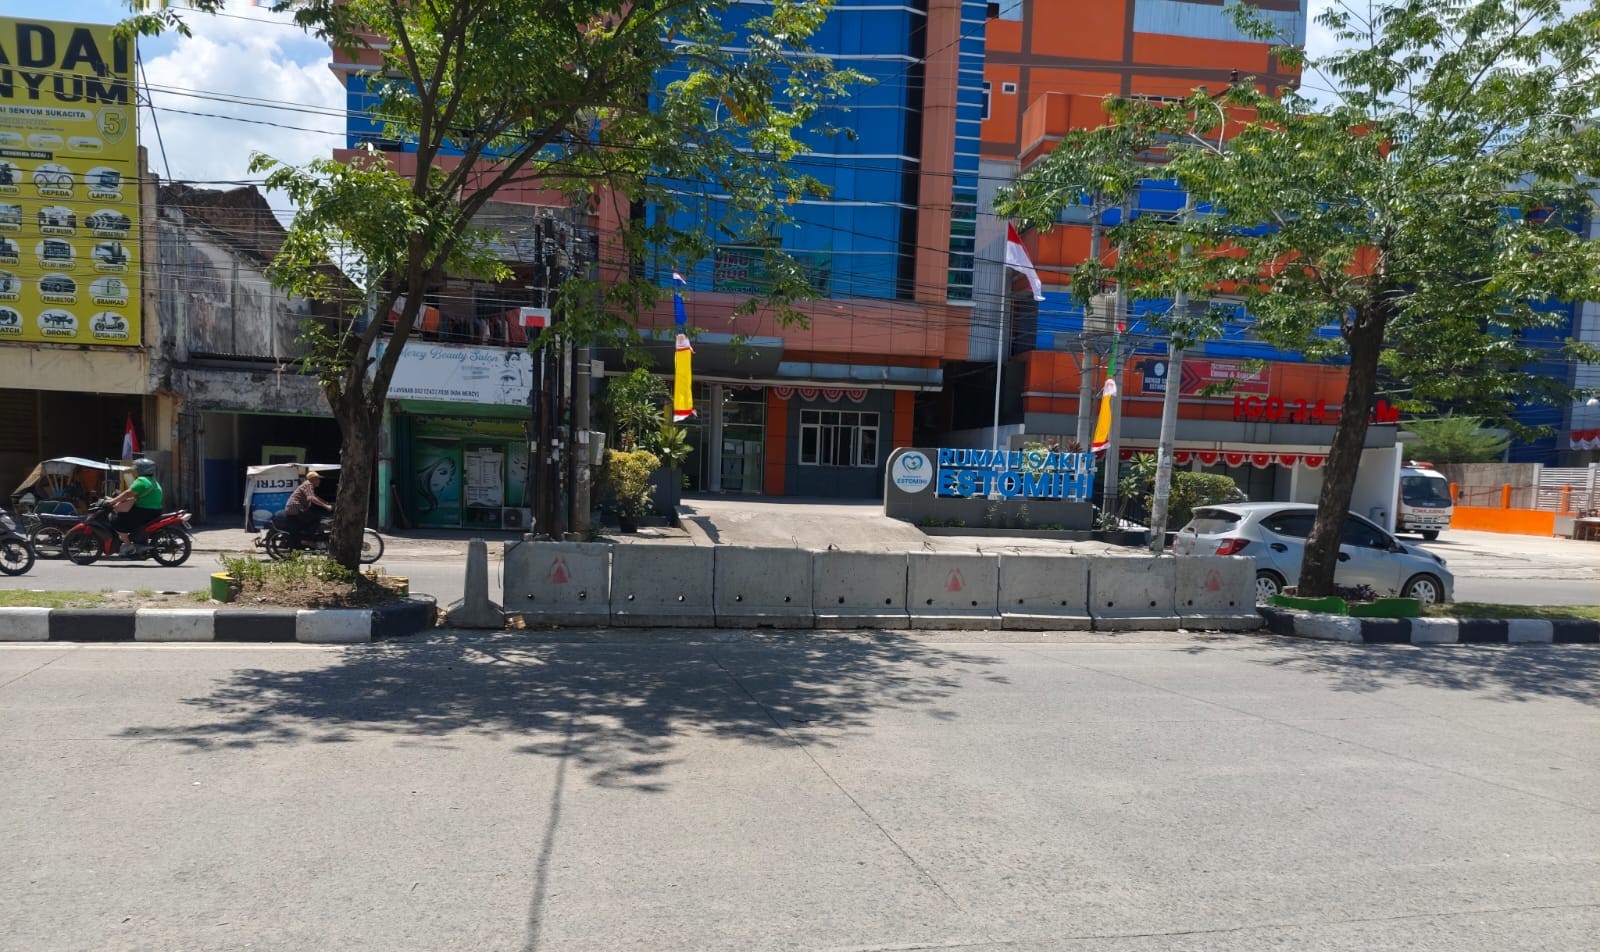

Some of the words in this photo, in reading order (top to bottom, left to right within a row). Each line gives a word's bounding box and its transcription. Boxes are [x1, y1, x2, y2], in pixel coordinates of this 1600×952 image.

[0, 23, 128, 73] DAI
[9, 107, 42, 115] SENYUM
[45, 109, 86, 118] SUKACITA
[103, 112, 121, 135] 5
[1233, 395, 1283, 419] IGD
[1294, 398, 1327, 420] 24
[939, 447, 1022, 468] RUMAH
[1028, 450, 1096, 471] SAKIT
[938, 468, 1094, 499] ESTOMIHI
